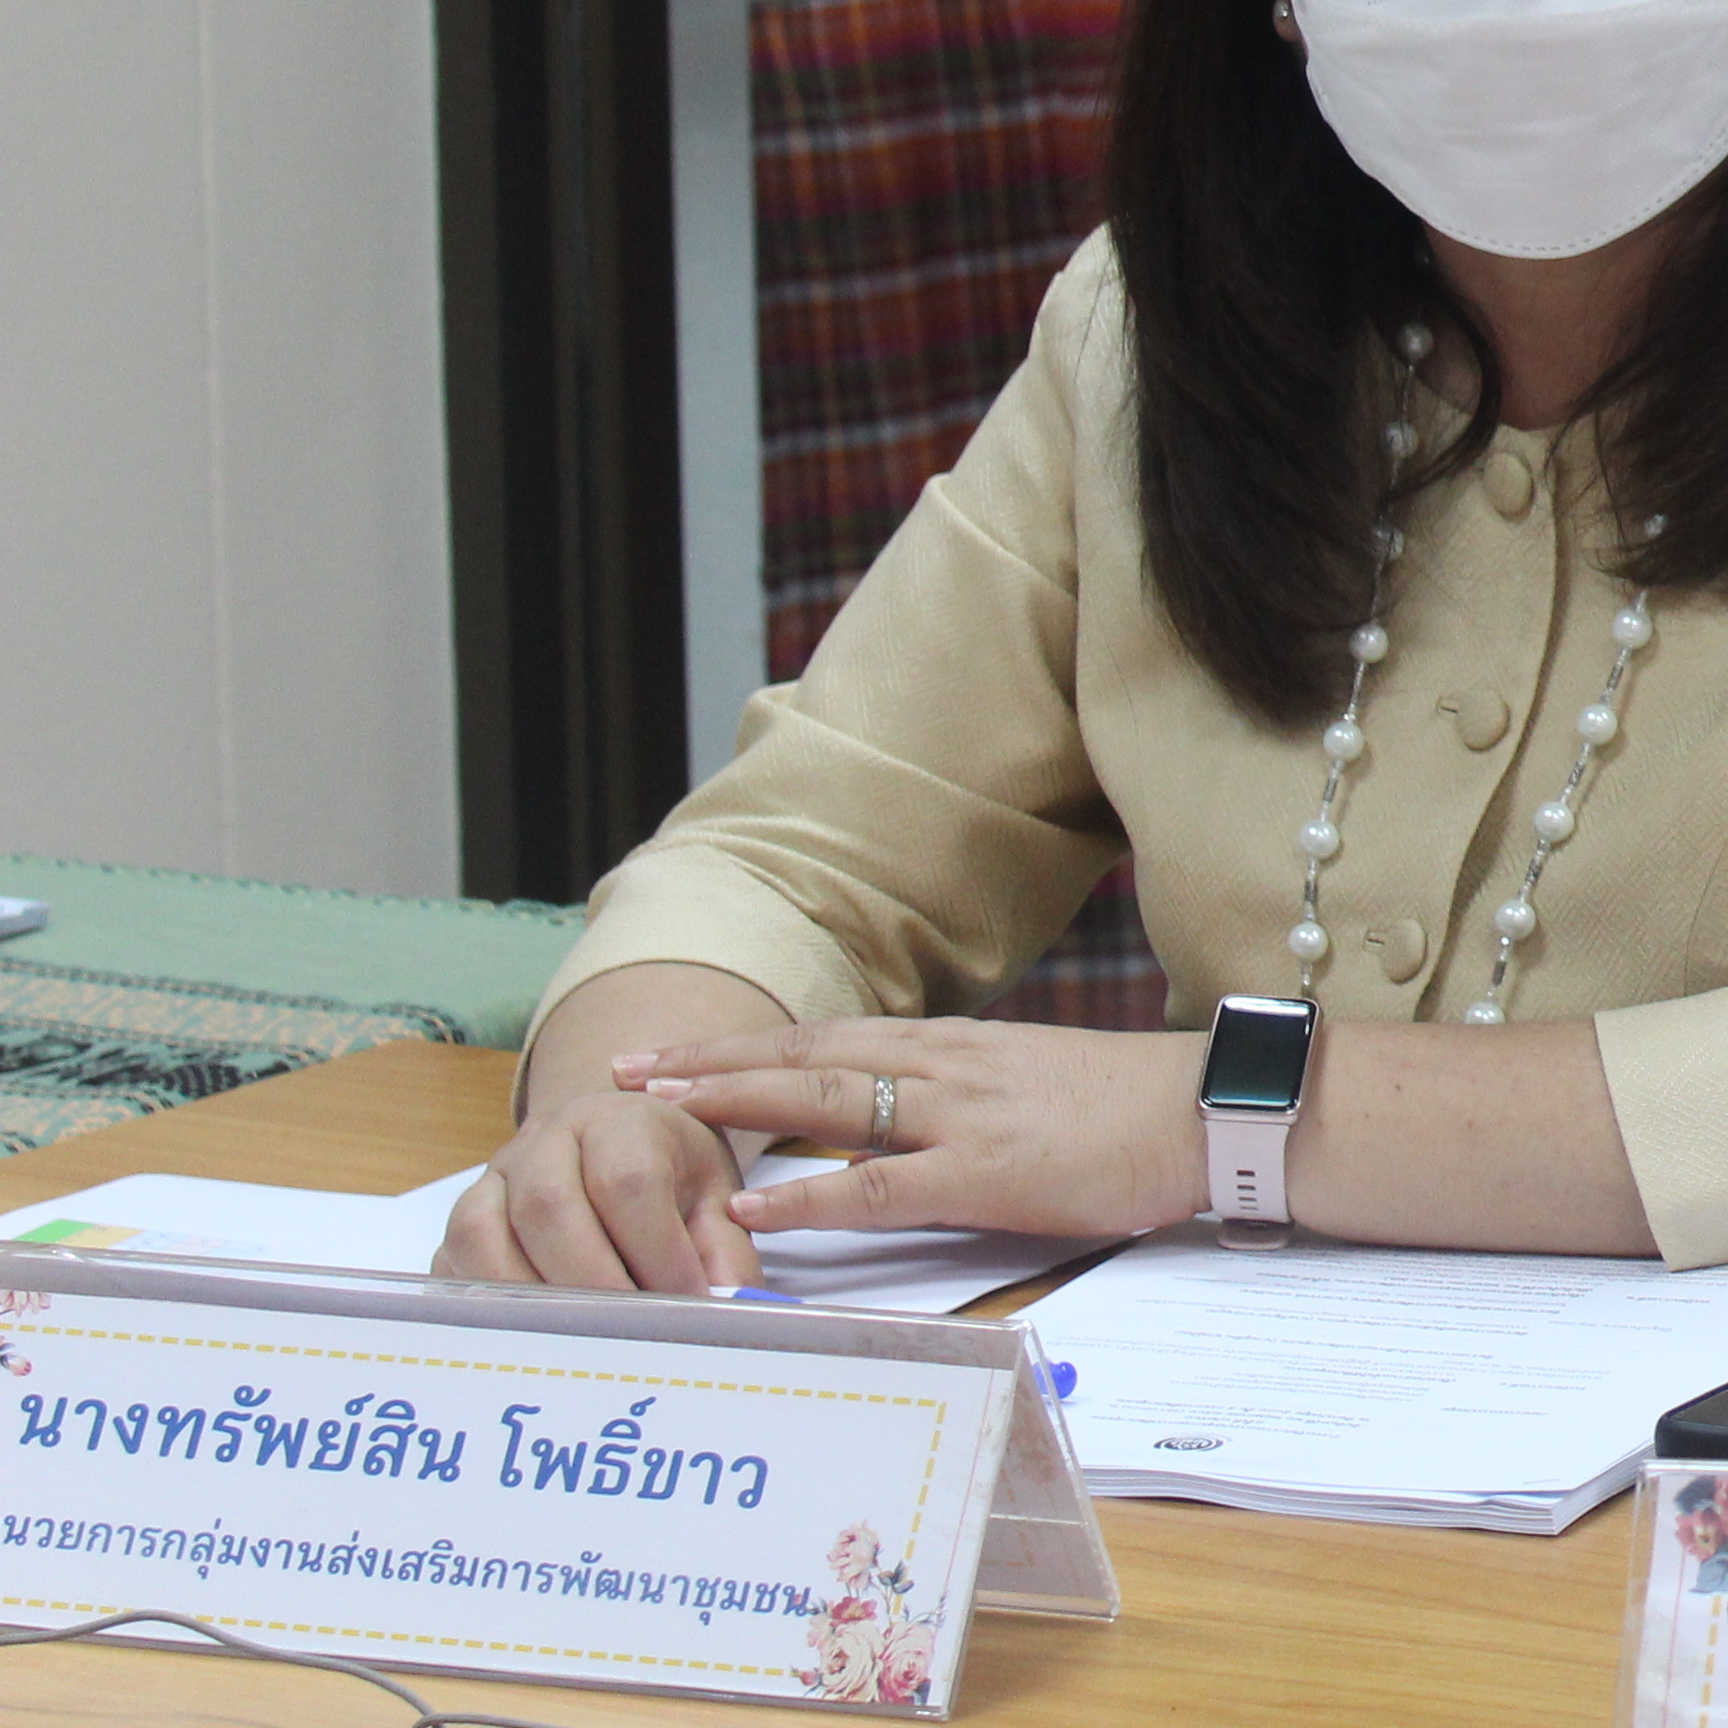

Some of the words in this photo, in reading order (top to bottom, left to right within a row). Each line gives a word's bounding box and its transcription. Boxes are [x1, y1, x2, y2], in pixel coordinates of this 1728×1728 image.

[19, 1384, 467, 1482] นางทรัพย์สิน
[499, 1396, 769, 1509] โพธิ์ขาว
